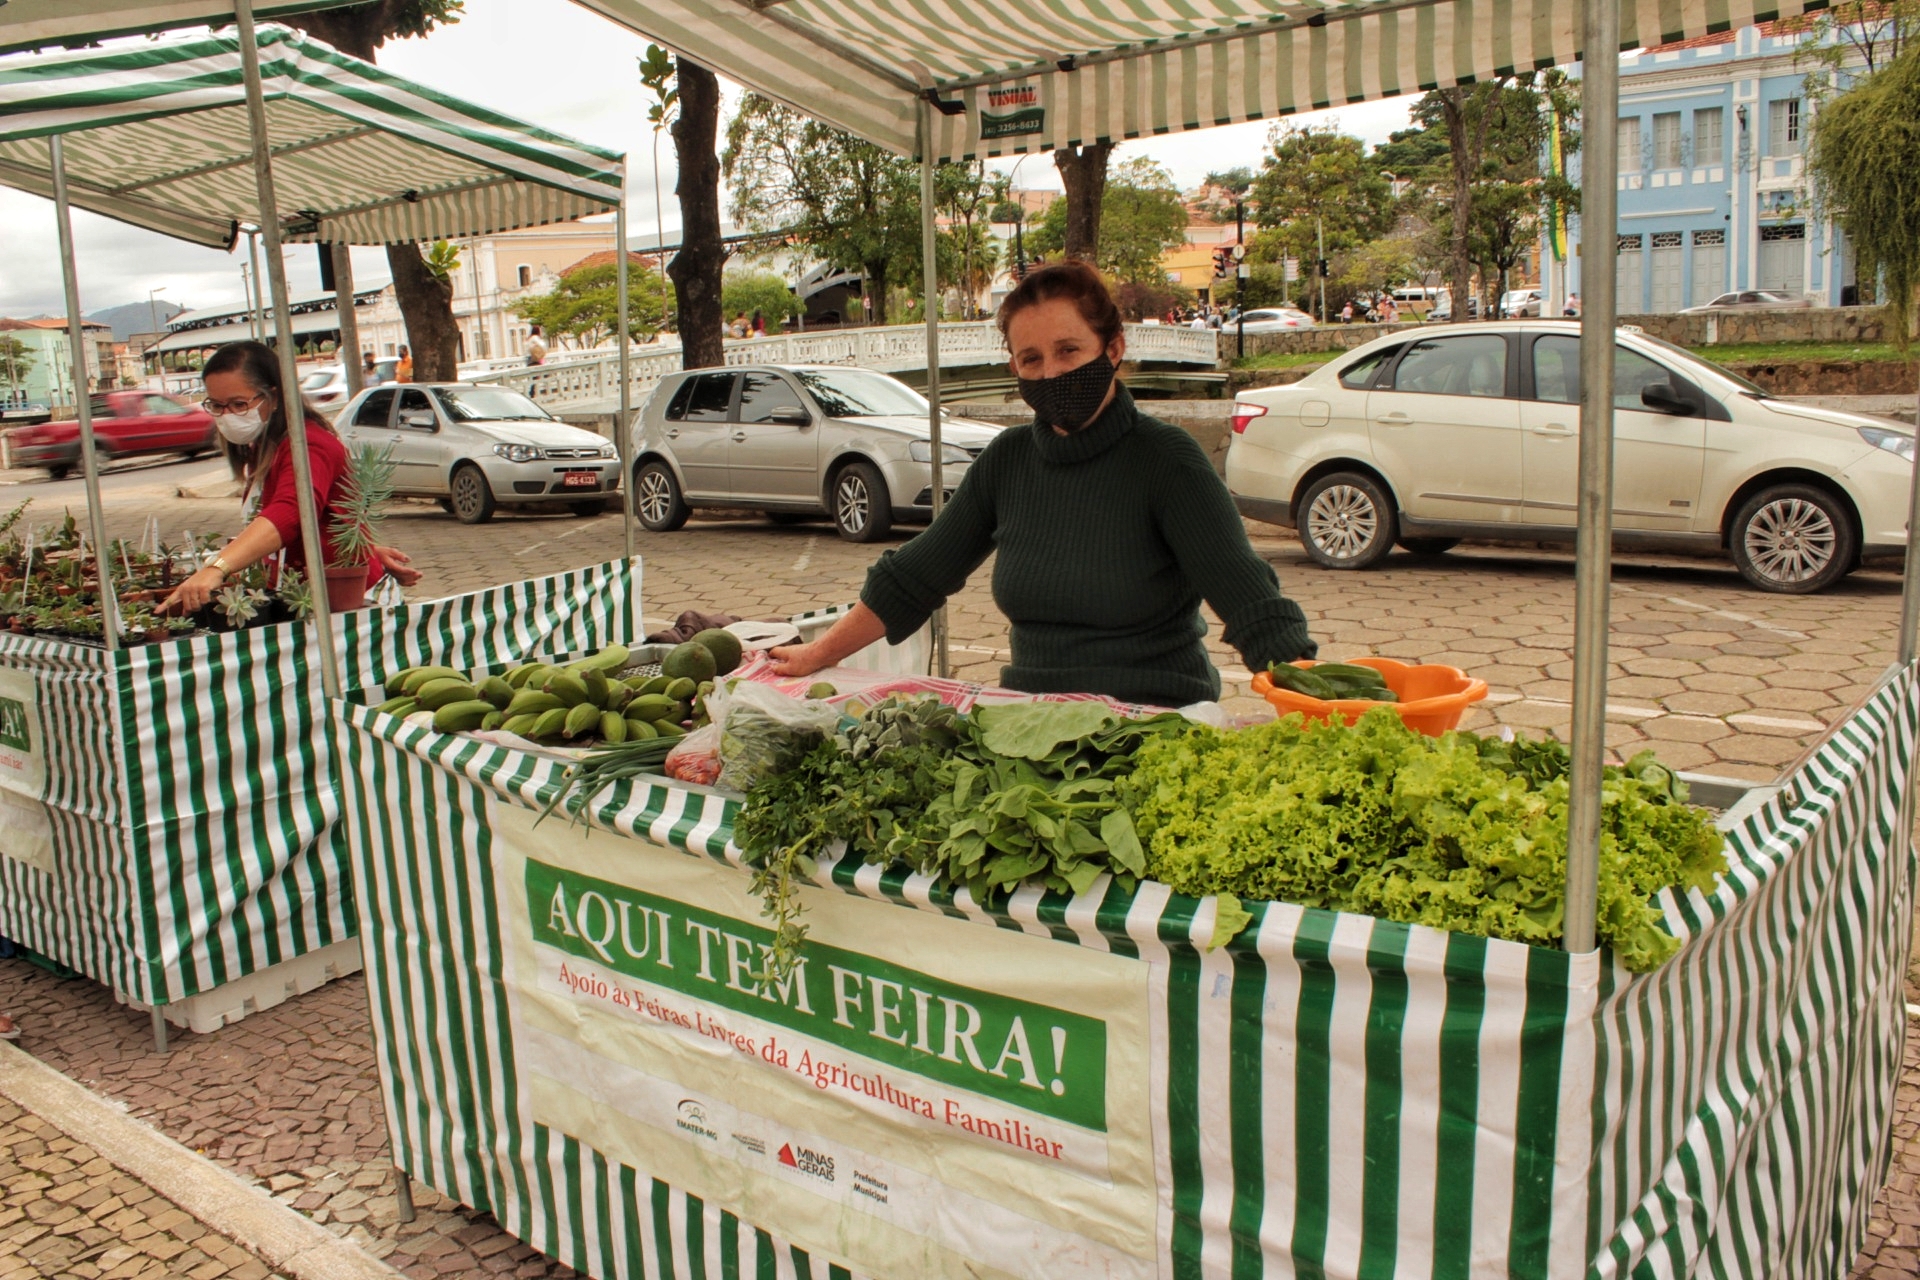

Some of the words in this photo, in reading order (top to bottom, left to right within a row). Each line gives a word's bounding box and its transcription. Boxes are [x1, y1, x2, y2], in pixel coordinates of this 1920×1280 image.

[988, 86, 1037, 107] VISUAL
[548, 881, 674, 969] AQUI
[686, 917, 815, 1016] TEM
[828, 964, 1067, 1096] FEIRA!
[558, 962, 608, 999] Apoio
[612, 980, 630, 1008] às
[633, 989, 692, 1030] Feiras
[695, 1011, 755, 1056] Livres
[761, 1037, 788, 1068] da
[795, 1049, 935, 1120] Agricultura
[943, 1098, 1064, 1160] Familiar
[797, 1145, 835, 1170] MINAS
[797, 1159, 835, 1182] GERAIS
[853, 1170, 888, 1191] Prefeitura
[853, 1183, 888, 1204] Municipal
